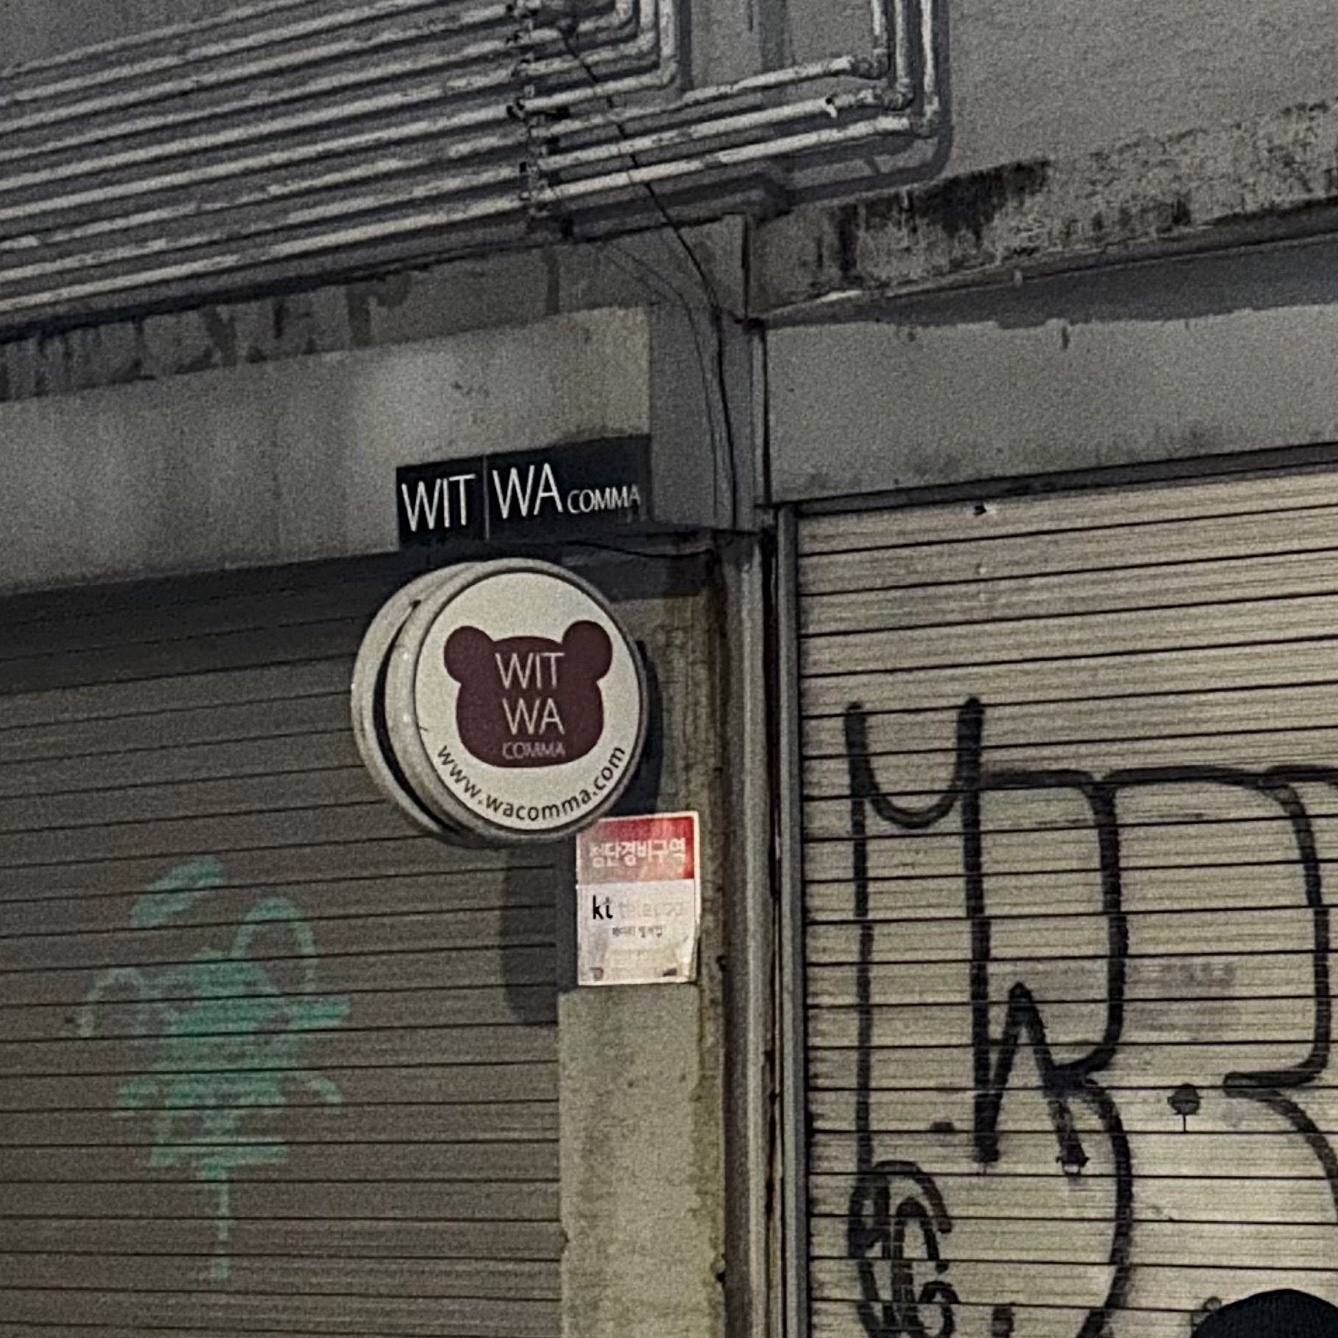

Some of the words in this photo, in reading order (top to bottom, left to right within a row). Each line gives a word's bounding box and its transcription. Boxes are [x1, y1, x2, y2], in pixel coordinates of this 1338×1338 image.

[401, 472, 476, 533] WIT
[492, 462, 564, 519] WA
[567, 485, 642, 515] COMMA
[495, 651, 566, 690] WIT
[502, 699, 566, 736] WA
[501, 741, 567, 760] COMMA
[436, 744, 627, 822] www.wacomma.com
